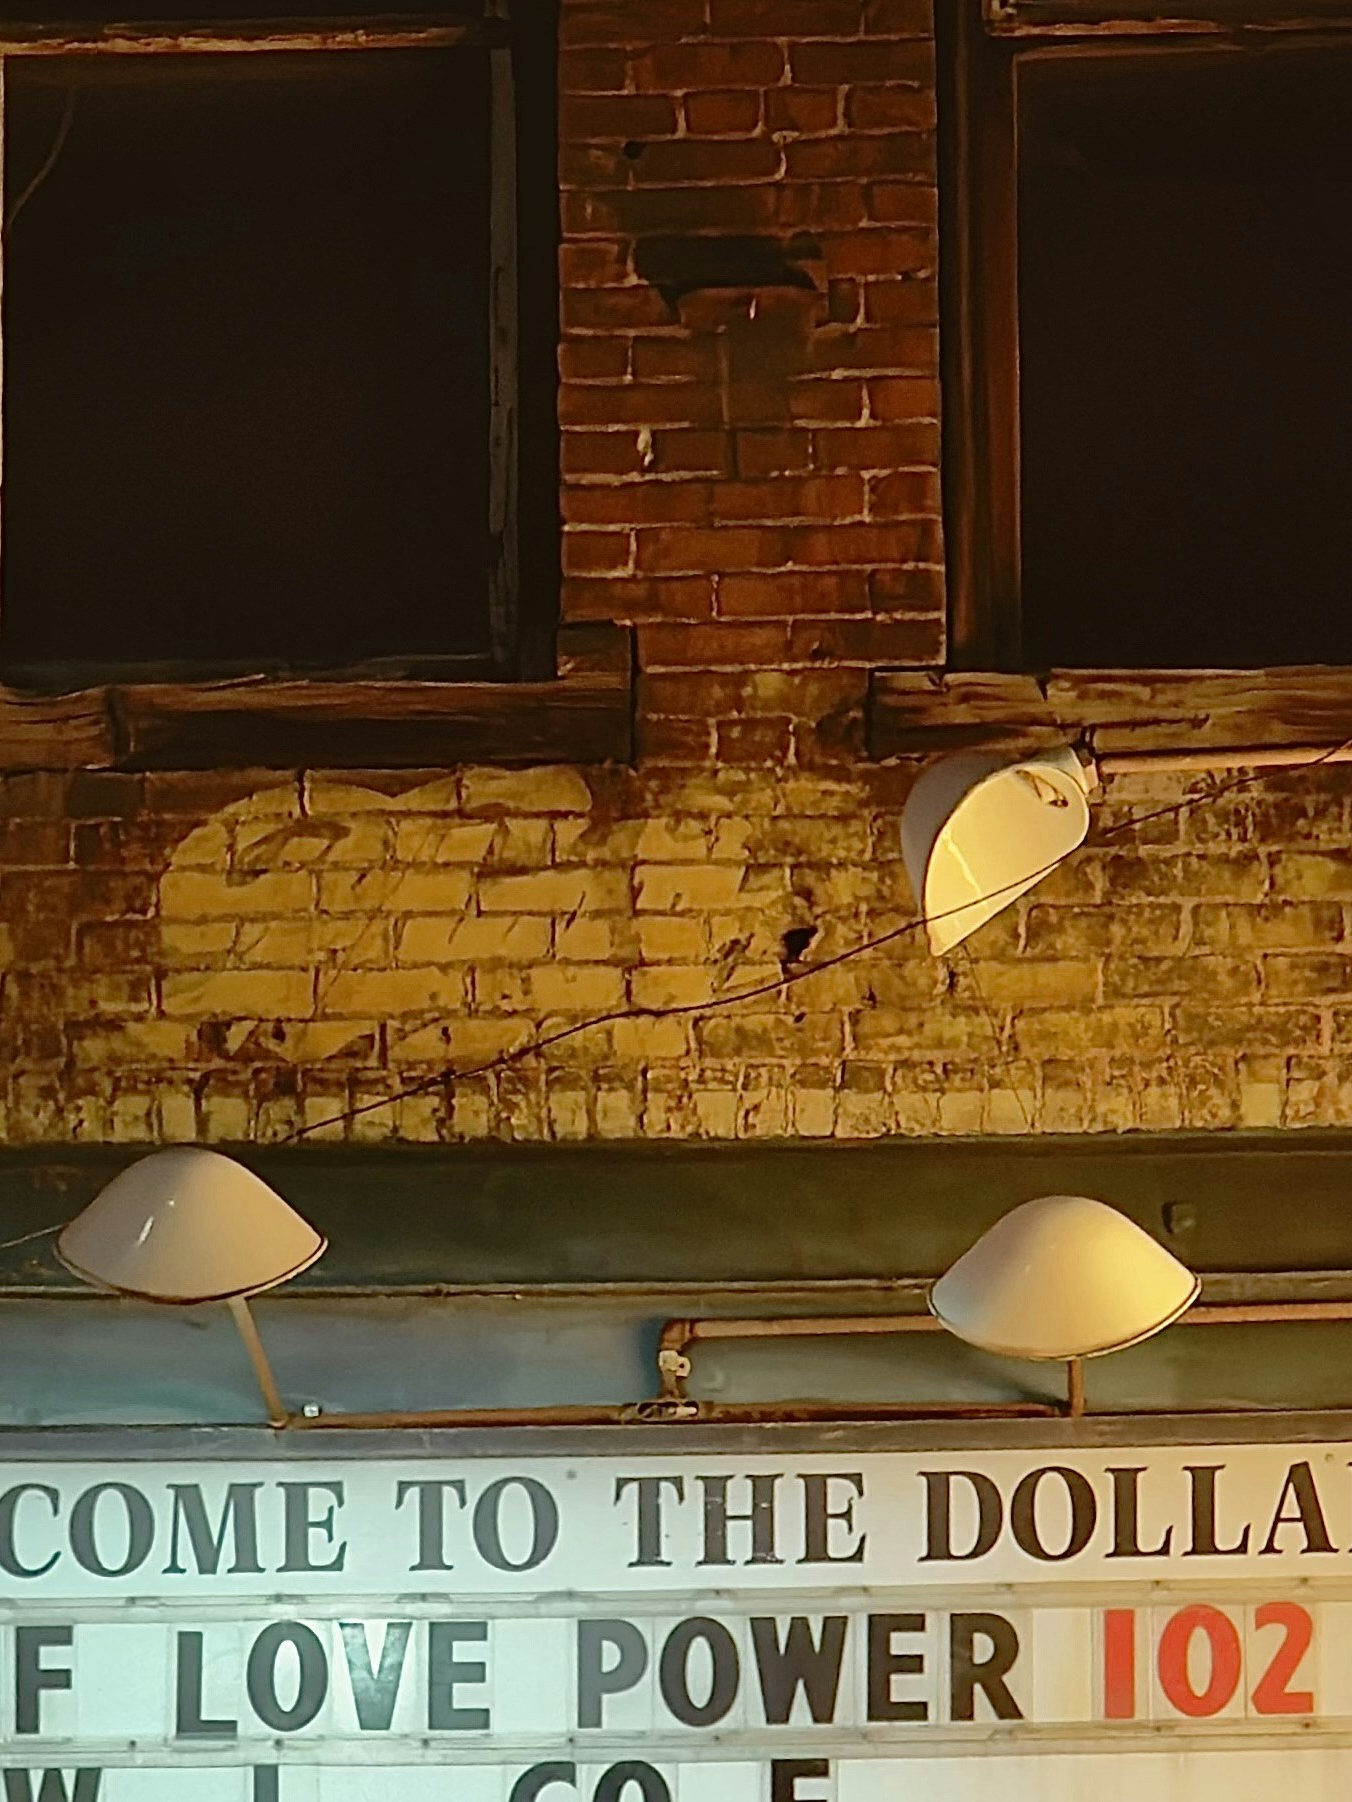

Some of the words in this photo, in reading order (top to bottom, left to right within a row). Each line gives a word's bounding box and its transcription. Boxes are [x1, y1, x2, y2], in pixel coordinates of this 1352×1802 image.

[395, 1477, 558, 1571] TO
[614, 1473, 867, 1568] THE
[176, 1619, 492, 1741] LOVE
[578, 1612, 1024, 1729] POWER
